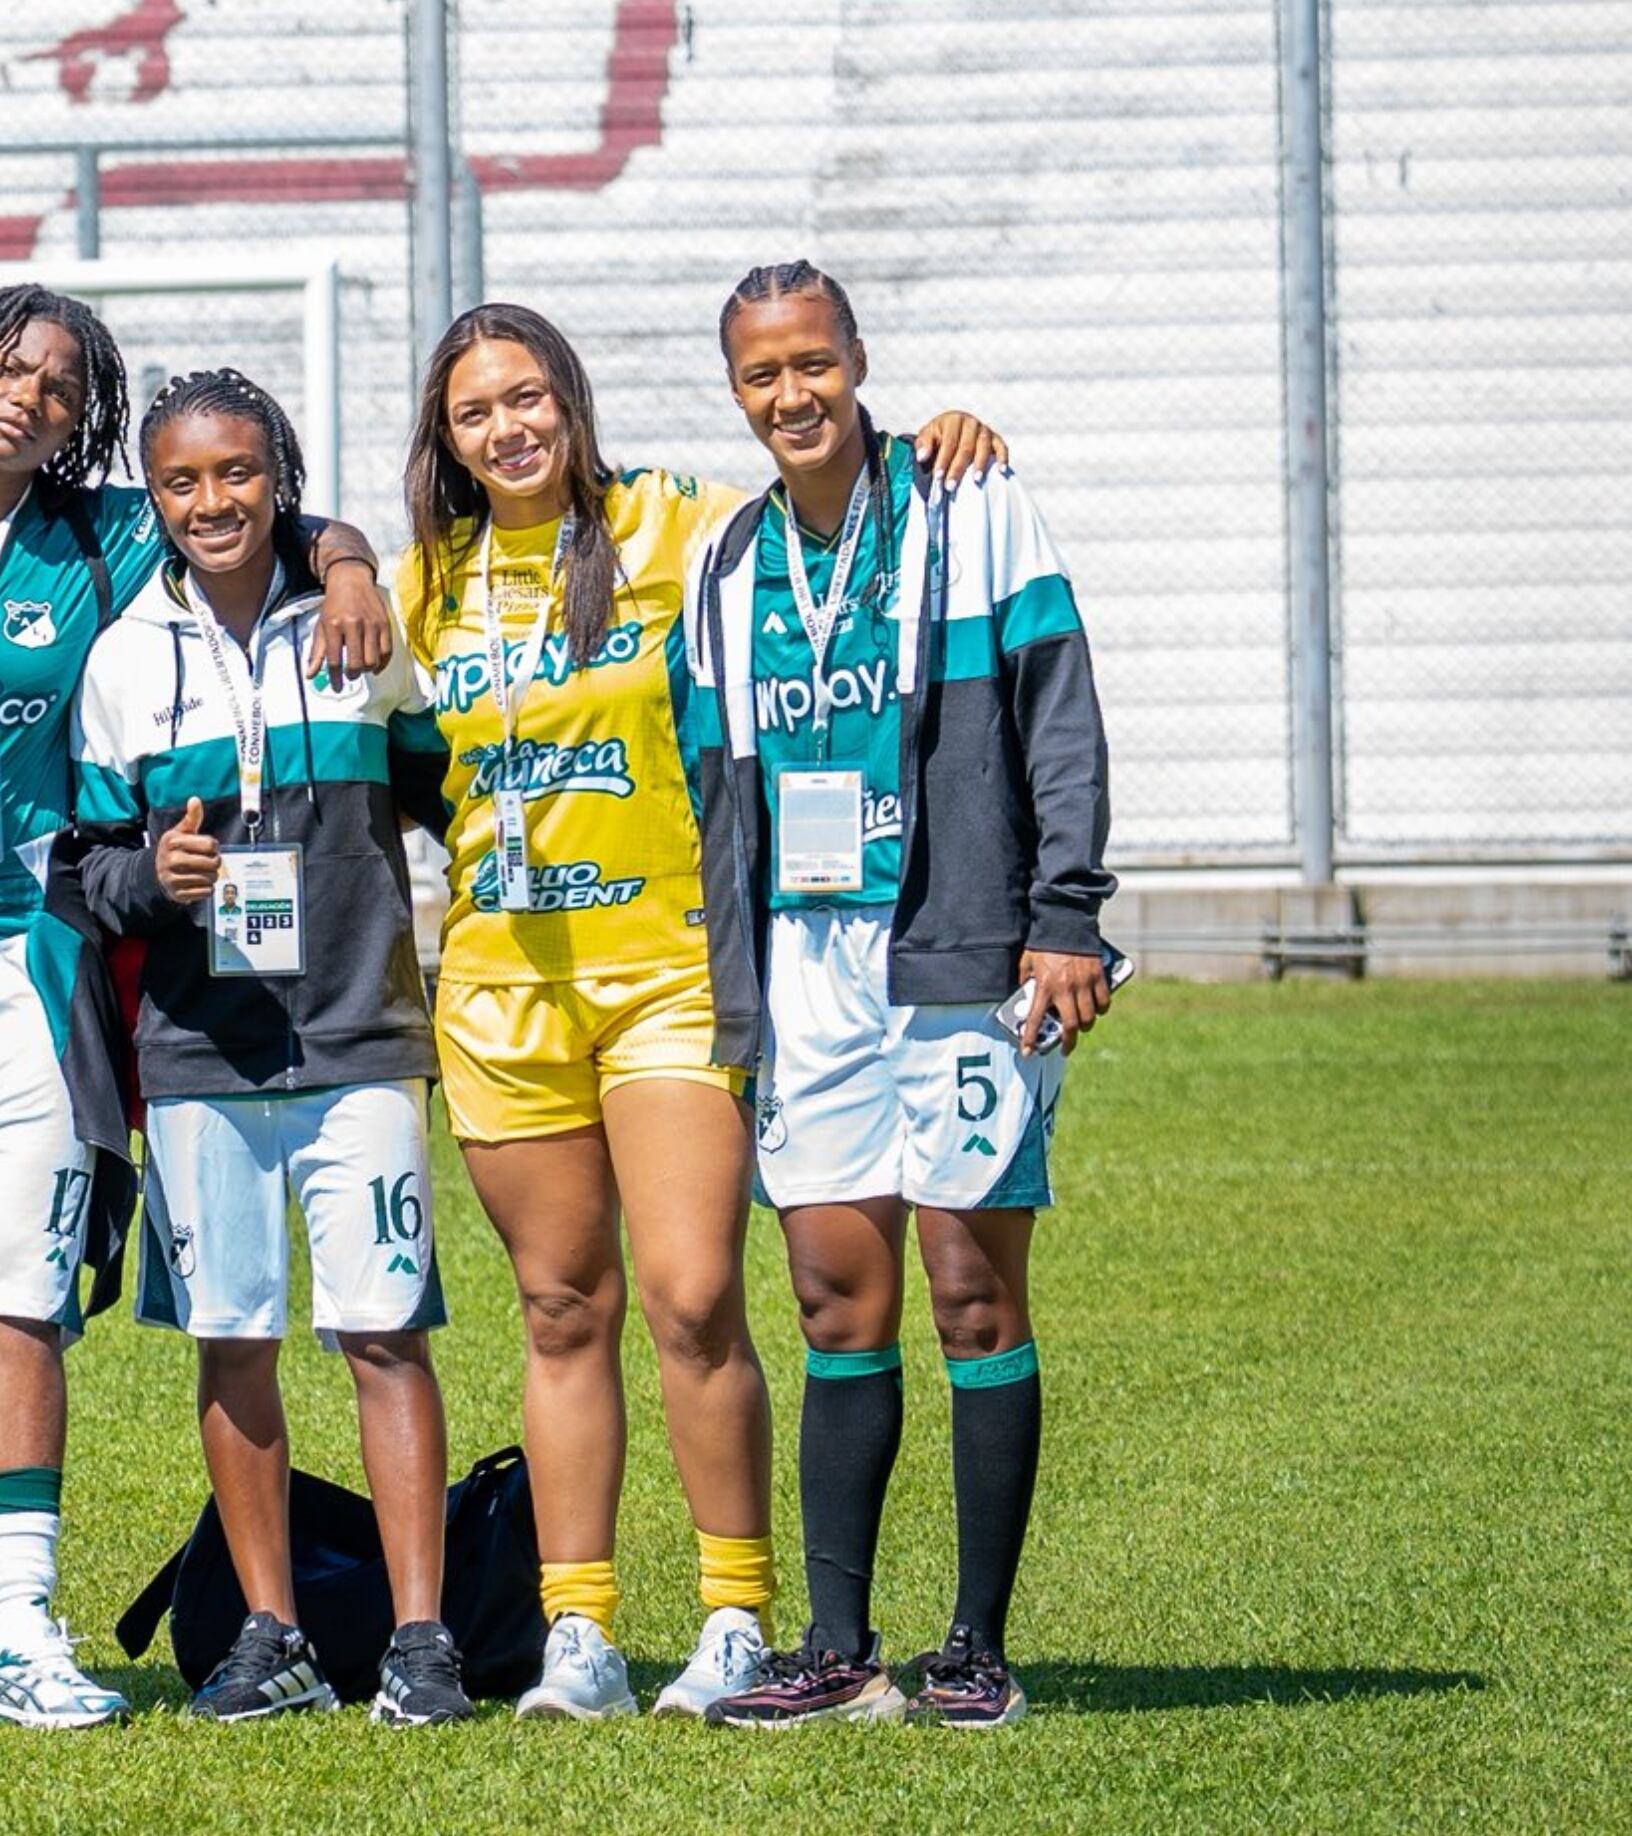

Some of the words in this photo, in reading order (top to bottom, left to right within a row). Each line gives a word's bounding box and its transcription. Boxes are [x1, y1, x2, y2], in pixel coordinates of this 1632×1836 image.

[502, 568, 541, 587] Little
[525, 863, 598, 885] LUO
[955, 1052, 998, 1122] 5
[45, 1167, 91, 1238] 17
[369, 1171, 423, 1246] 16
